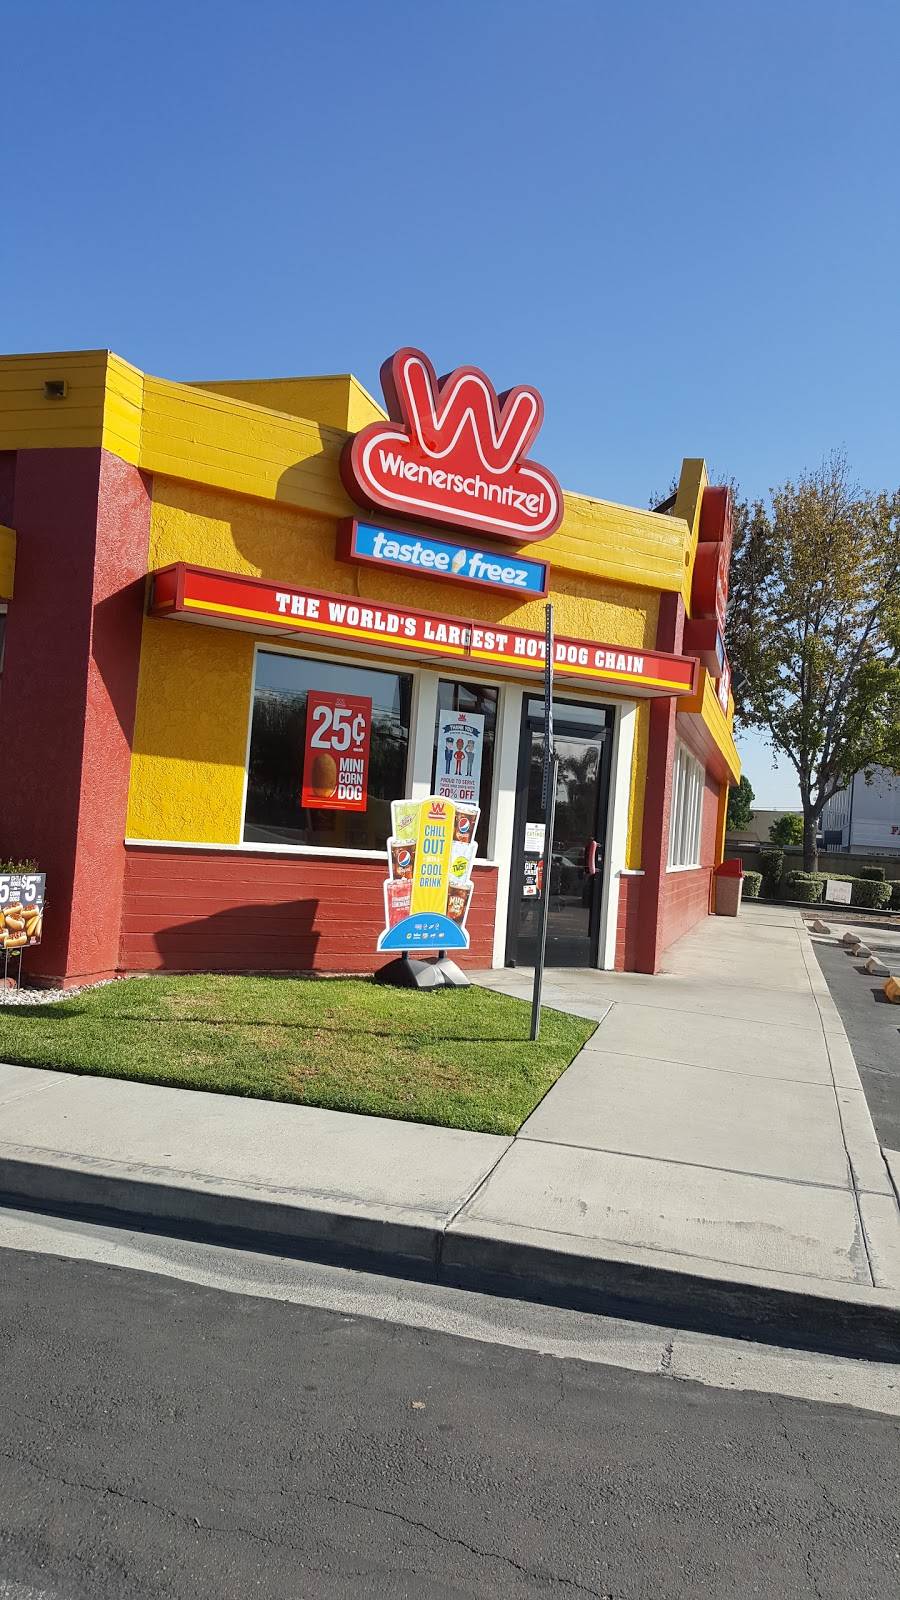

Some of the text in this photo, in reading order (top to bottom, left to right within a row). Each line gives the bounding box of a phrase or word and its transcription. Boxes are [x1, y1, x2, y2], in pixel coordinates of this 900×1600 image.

[378, 449, 545, 518] Wienerschnitzel
[373, 532, 529, 587] tastee freez
[275, 592, 644, 674] THE WORLD'S LARGEST HOT DOG CHAIN
[311, 705, 365, 751] 25¢
[339, 757, 364, 773] MINI
[338, 772, 363, 785] CORN
[337, 784, 362, 801] DOG
[439, 788, 475, 800] 20% OFF
[425, 824, 445, 837] CHILL
[423, 838, 445, 854] OUT
[421, 863, 442, 876] COOL
[420, 877, 441, 888] DRINK
